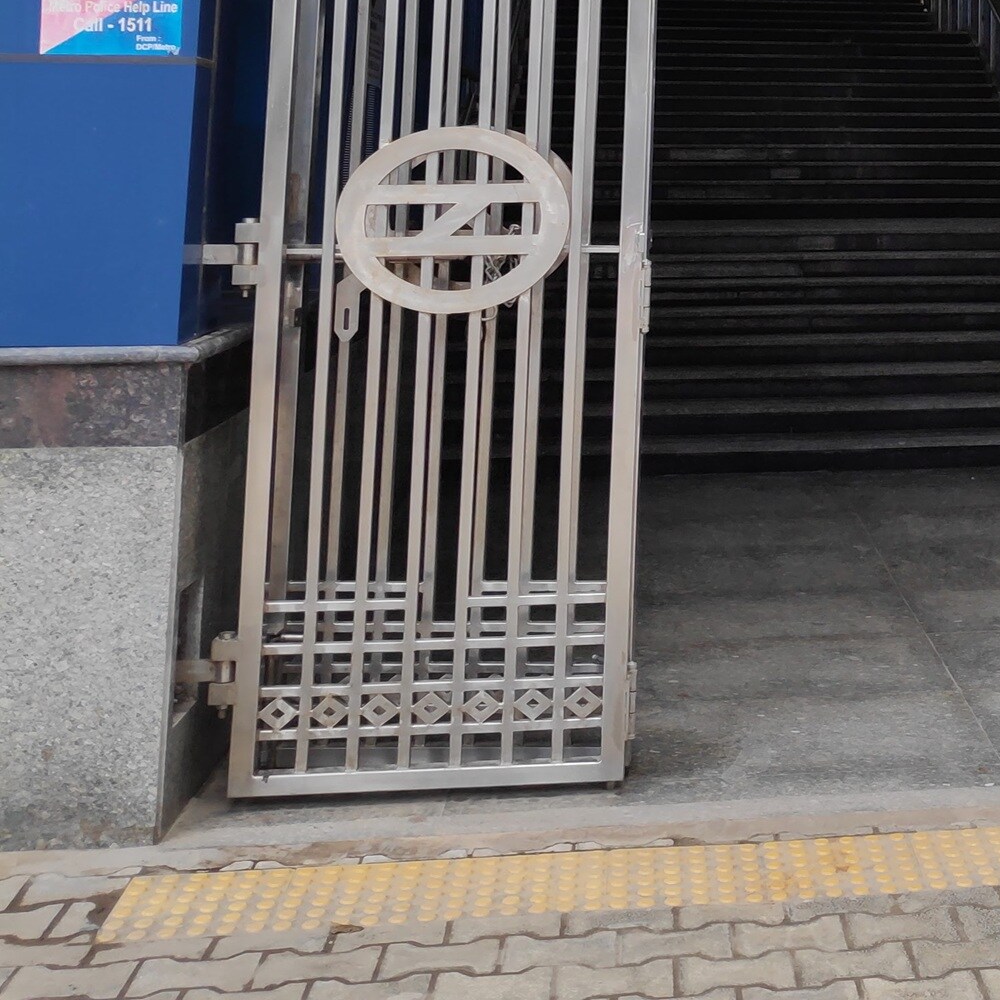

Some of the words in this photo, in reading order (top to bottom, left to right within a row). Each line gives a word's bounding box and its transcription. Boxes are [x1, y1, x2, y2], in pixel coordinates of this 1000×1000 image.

[85, 1, 120, 13] Police
[124, 1, 150, 15] Help
[152, 1, 178, 13] Line
[74, 18, 103, 32] Call
[118, 18, 153, 32] 1511
